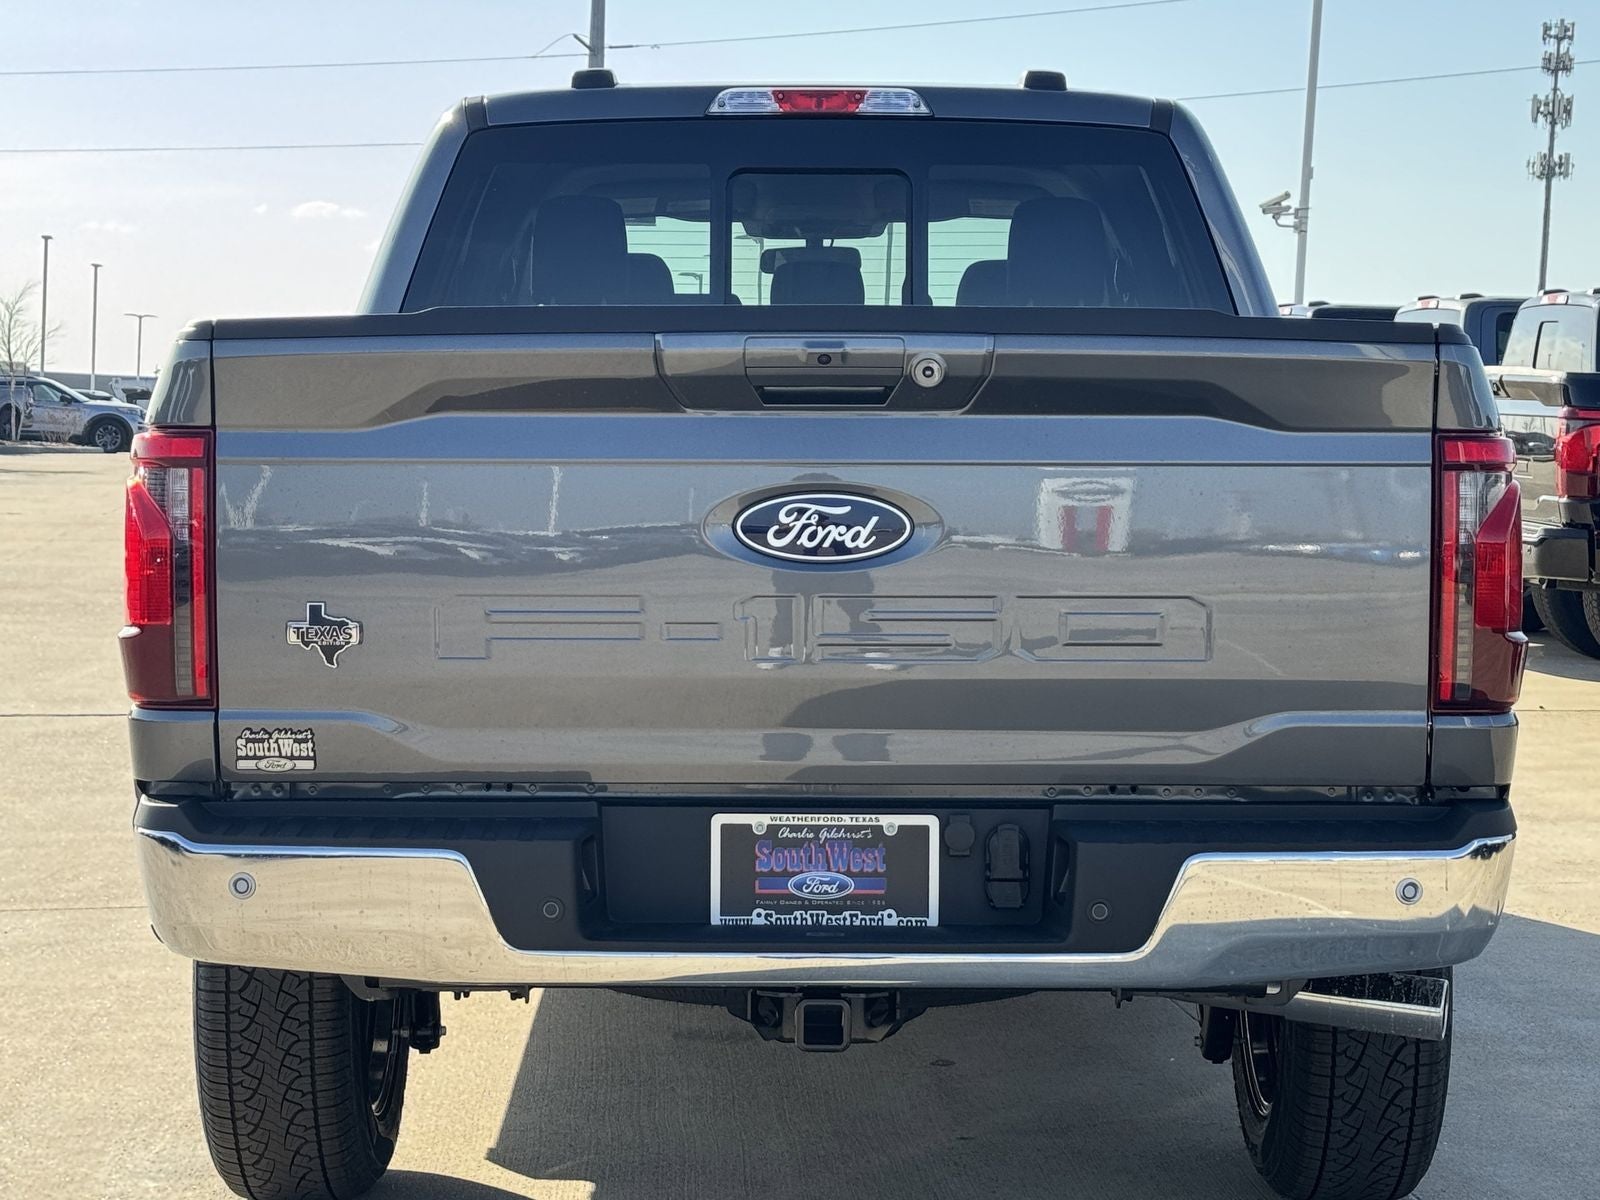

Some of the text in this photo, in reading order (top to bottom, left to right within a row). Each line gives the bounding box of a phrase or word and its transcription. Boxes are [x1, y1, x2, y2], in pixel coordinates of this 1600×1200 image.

[767, 503, 879, 548] Ford
[292, 625, 353, 640] TEXAS
[434, 595, 1212, 661] F-150
[236, 738, 314, 757] SouthWest
[264, 760, 287, 769] Ford
[849, 816, 881, 824] TEXAS
[778, 827, 872, 843] Charlie Gilchrist's
[755, 839, 887, 873] SouthWest
[801, 876, 840, 894] Ford
